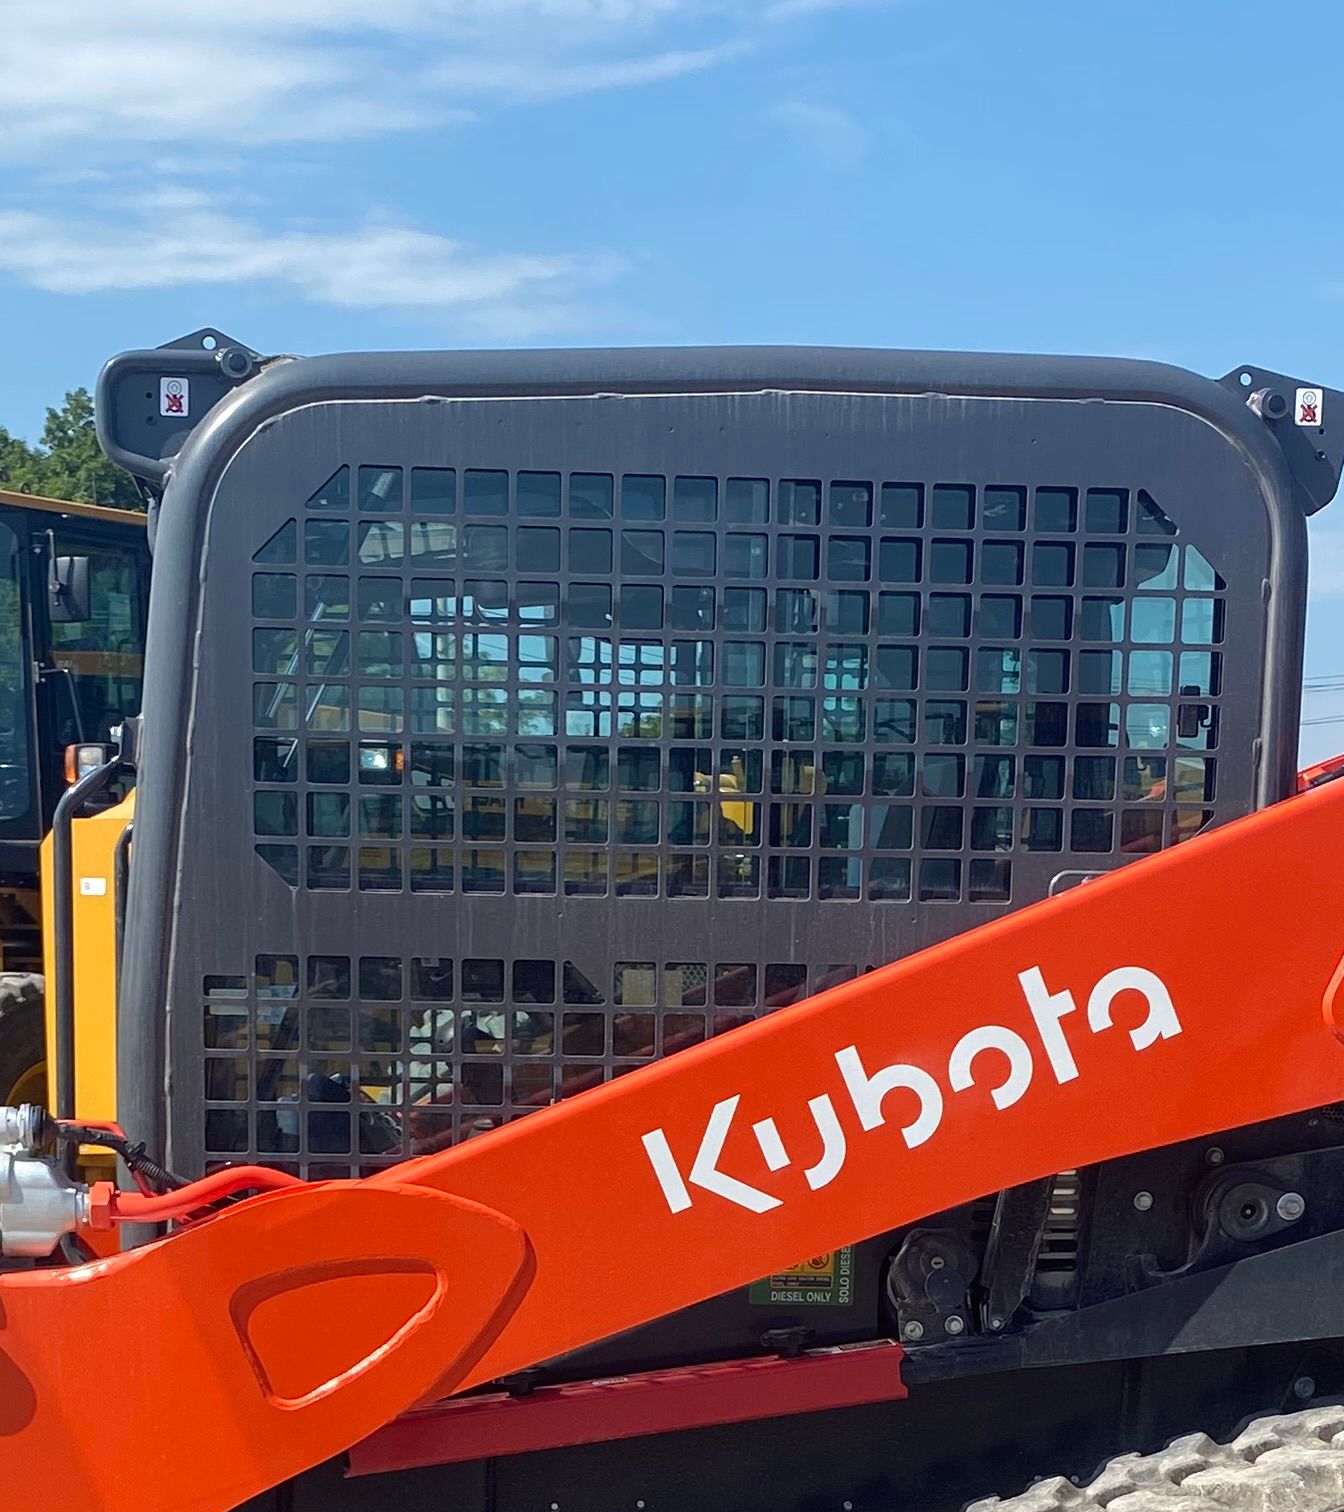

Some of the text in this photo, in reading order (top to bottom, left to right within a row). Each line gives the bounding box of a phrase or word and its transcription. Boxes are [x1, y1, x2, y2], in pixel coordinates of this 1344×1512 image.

[641, 965, 1183, 1215] Kubota
[771, 1291, 831, 1302] DIESEL ONLY
[839, 1278, 850, 1303] SOLO
